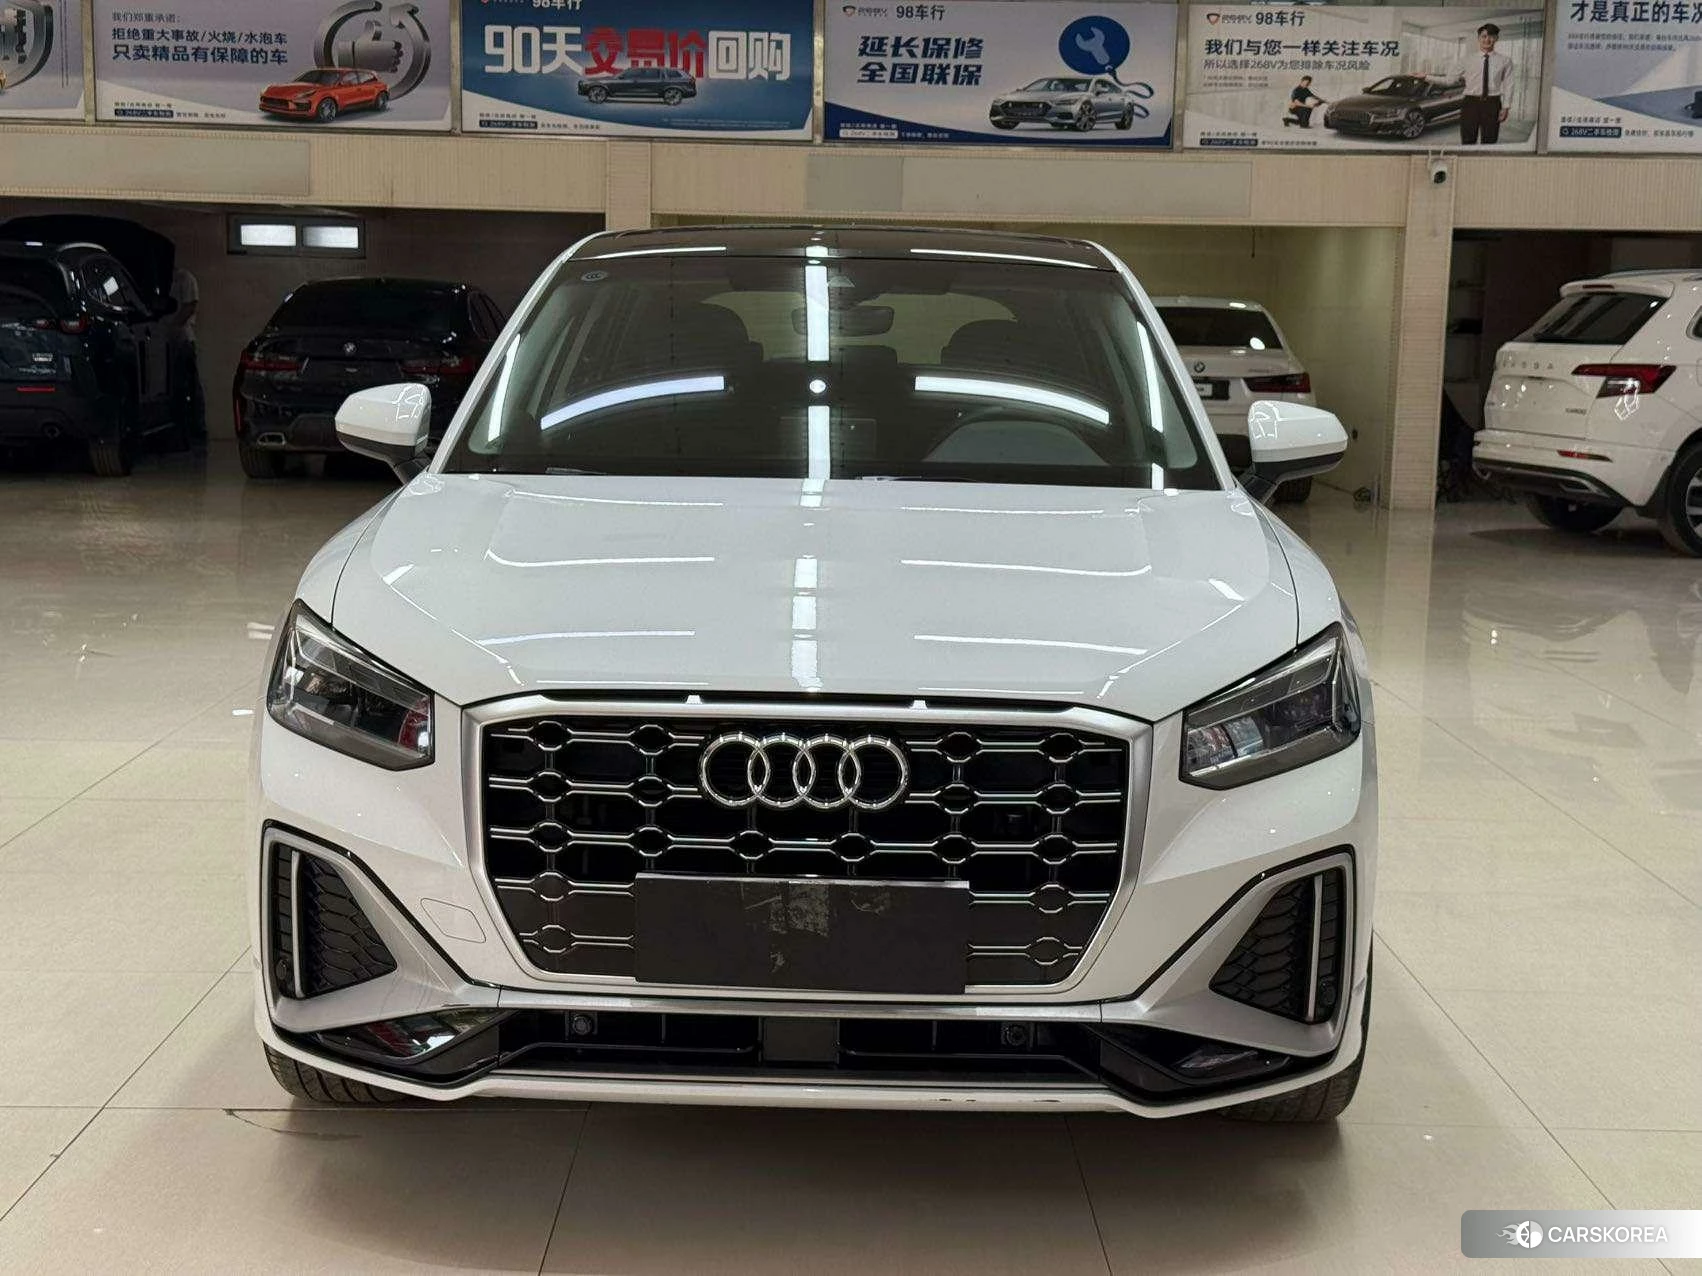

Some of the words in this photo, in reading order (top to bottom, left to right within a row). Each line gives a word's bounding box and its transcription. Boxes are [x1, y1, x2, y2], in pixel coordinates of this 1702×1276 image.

[896, 5, 945, 20] 98车行
[1255, 11, 1305, 26] 98车行
[111, 27, 288, 44] 拒绝重大事故/火烧/水泡车
[111, 44, 288, 65] 只卖精品有保障的车
[484, 24, 791, 80] 90天交易价回购
[858, 35, 984, 59] 延长保修
[1204, 38, 1400, 57] 我们与您一样关注车况
[856, 61, 983, 86] 全国联保
